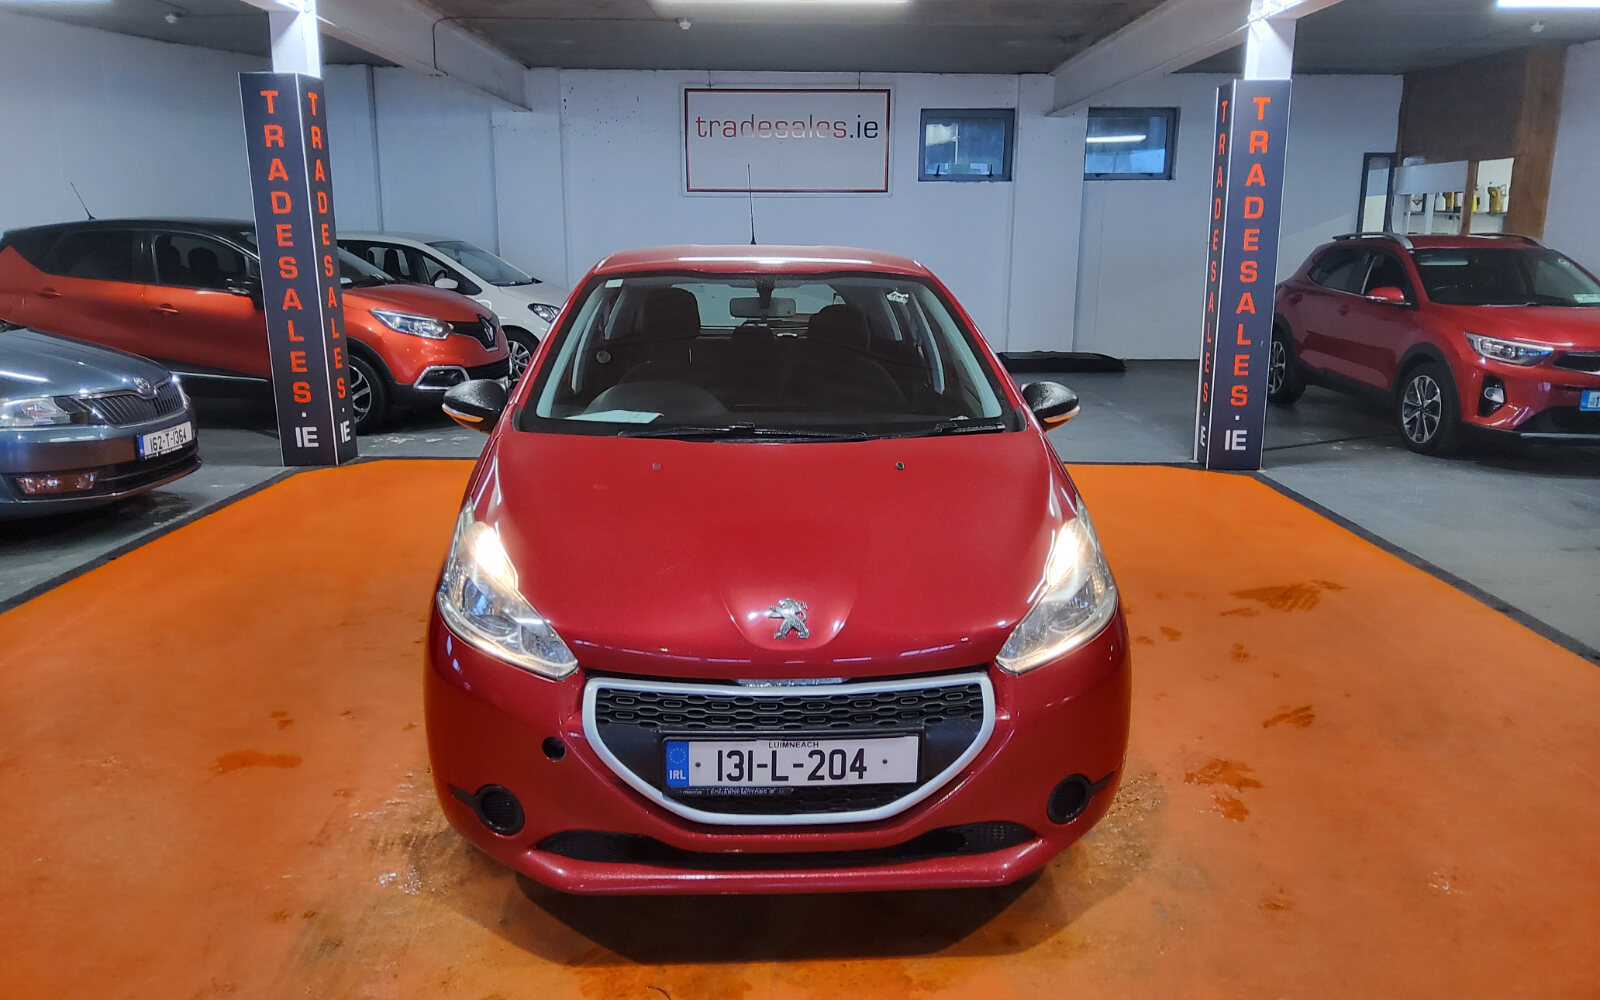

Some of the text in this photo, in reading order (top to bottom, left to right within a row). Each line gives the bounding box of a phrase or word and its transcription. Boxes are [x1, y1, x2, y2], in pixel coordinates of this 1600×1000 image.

[695, 114, 879, 139] tradesales.ie
[149, 427, 187, 452] 162-T-1364
[768, 740, 819, 749] LUIMNEACH
[669, 770, 686, 780] IRL
[717, 747, 867, 783] 131-L-204
